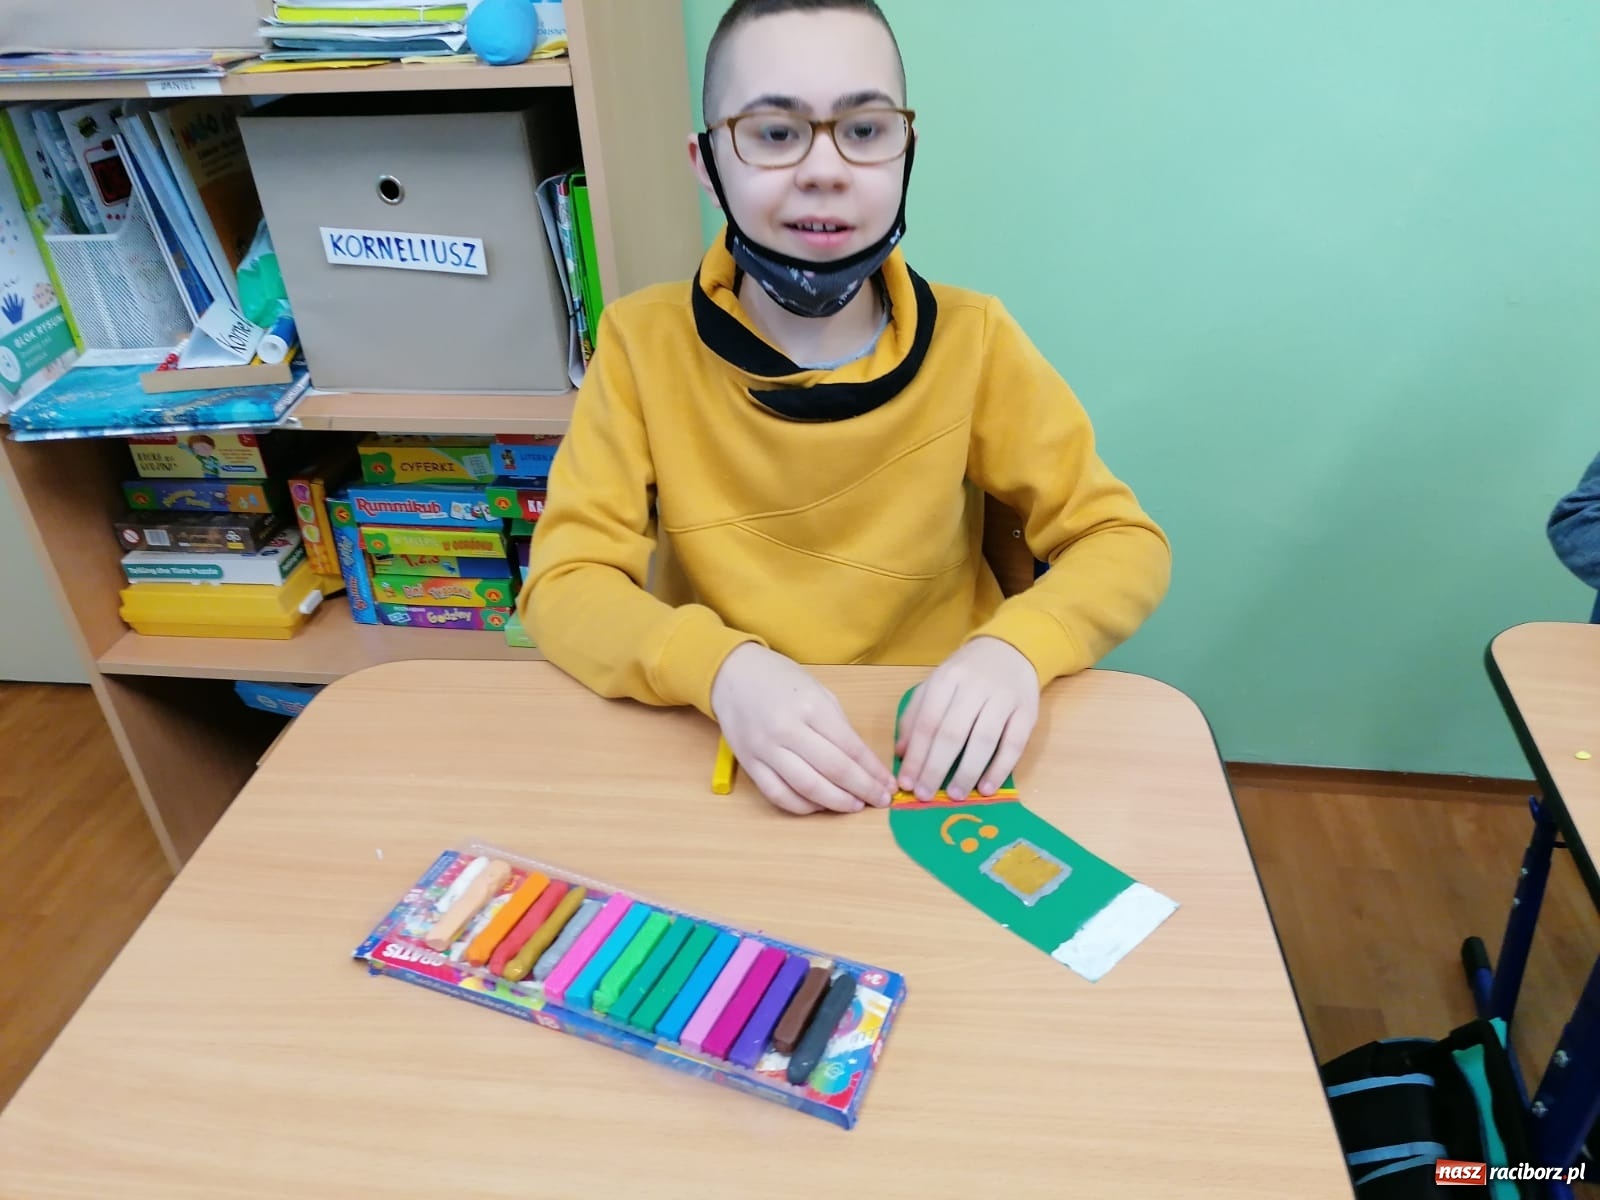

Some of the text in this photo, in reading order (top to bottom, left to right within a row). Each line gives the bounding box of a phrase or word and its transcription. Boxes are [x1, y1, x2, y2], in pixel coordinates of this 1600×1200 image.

[329, 233, 477, 269] KORNELIUSZ
[14, 329, 39, 349] BLOK
[400, 462, 456, 472] CYFERKI
[355, 497, 442, 517] Rummikub
[170, 567, 192, 575] Time
[191, 567, 219, 576] Puzzle
[382, 942, 445, 967] GRATIS
